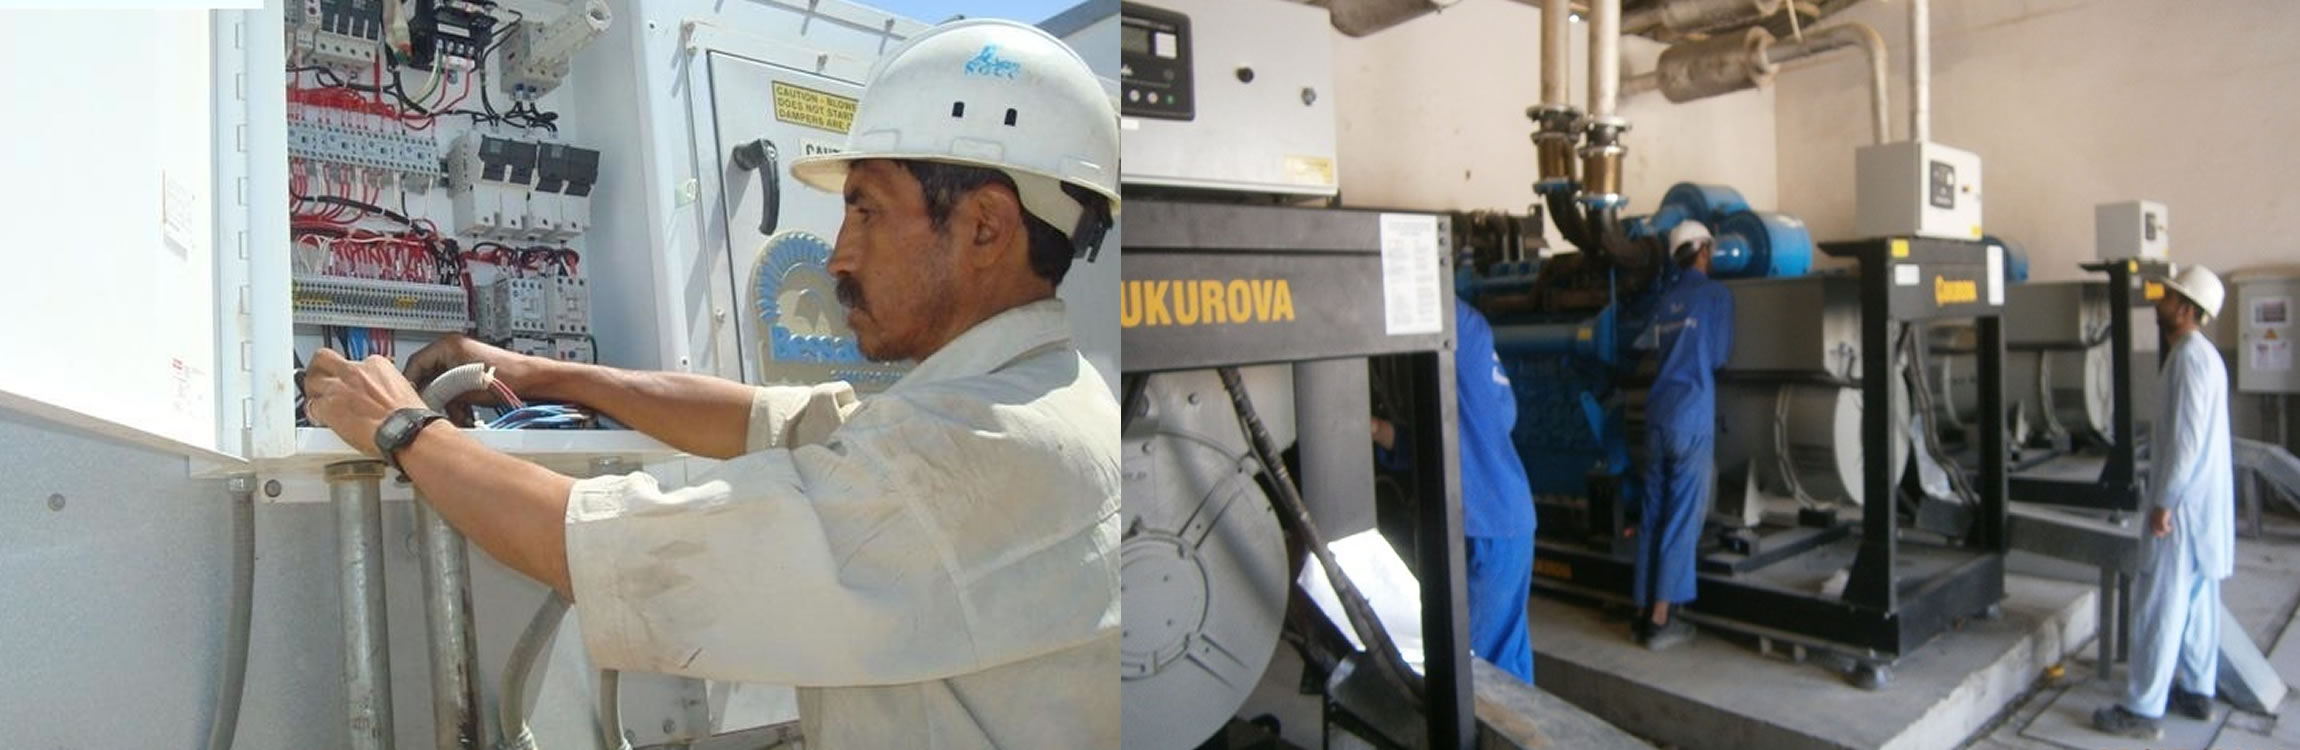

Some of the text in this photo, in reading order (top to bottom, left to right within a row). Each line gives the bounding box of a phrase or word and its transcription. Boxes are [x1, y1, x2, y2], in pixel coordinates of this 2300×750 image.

[776, 86, 819, 102] CAUTION
[778, 97, 803, 111] DOES
[806, 104, 824, 116] NOT
[779, 109, 824, 125] DAMPERS
[826, 119, 844, 129] ARE
[1121, 279, 1295, 328] UKUROVA
